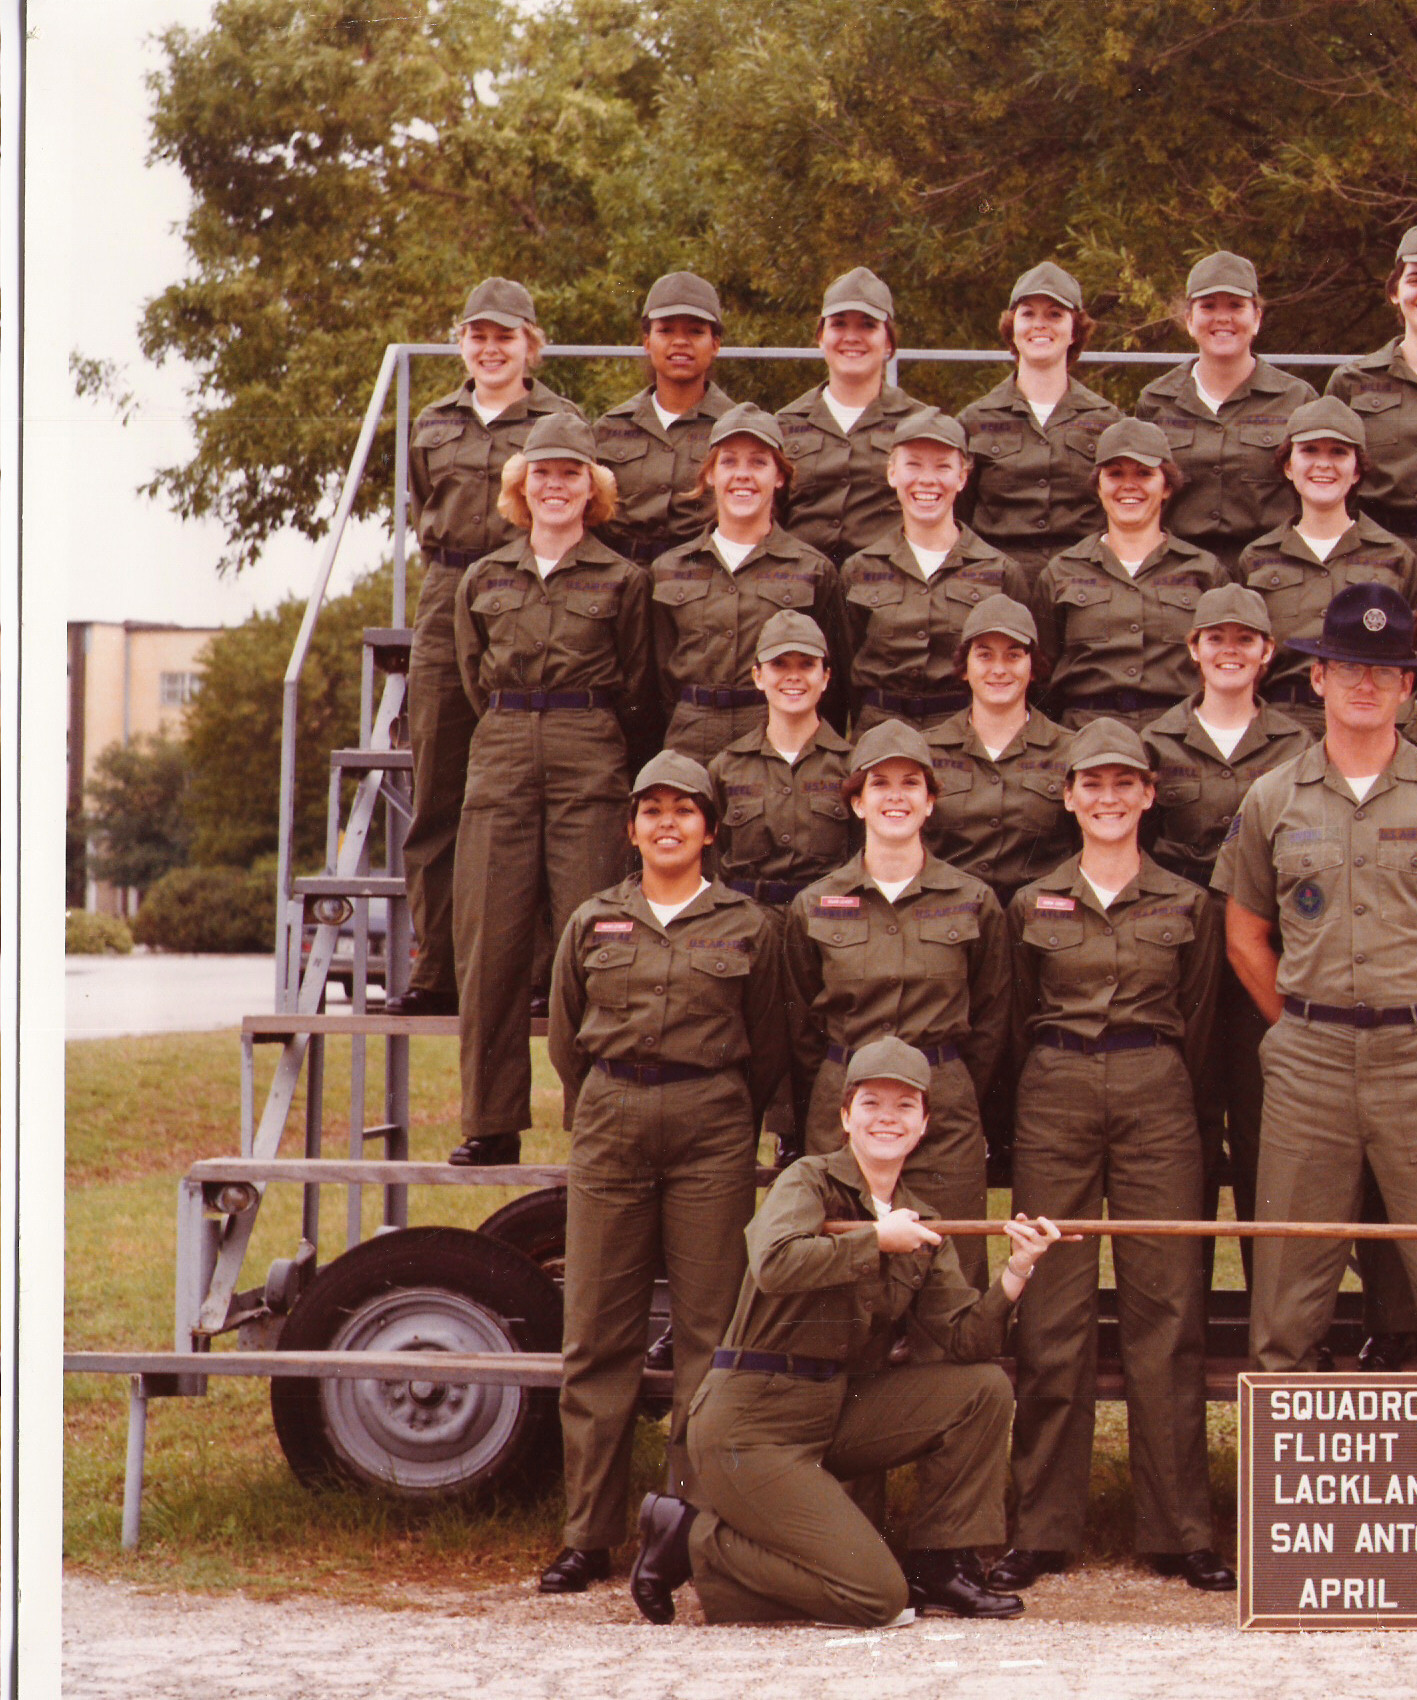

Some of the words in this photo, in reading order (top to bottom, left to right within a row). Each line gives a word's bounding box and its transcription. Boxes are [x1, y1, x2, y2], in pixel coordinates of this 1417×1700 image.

[1275, 1433, 1398, 1461] FLIGHT
[1272, 1523, 1333, 1552] SAN
[1300, 1579, 1397, 1608] APRIL
